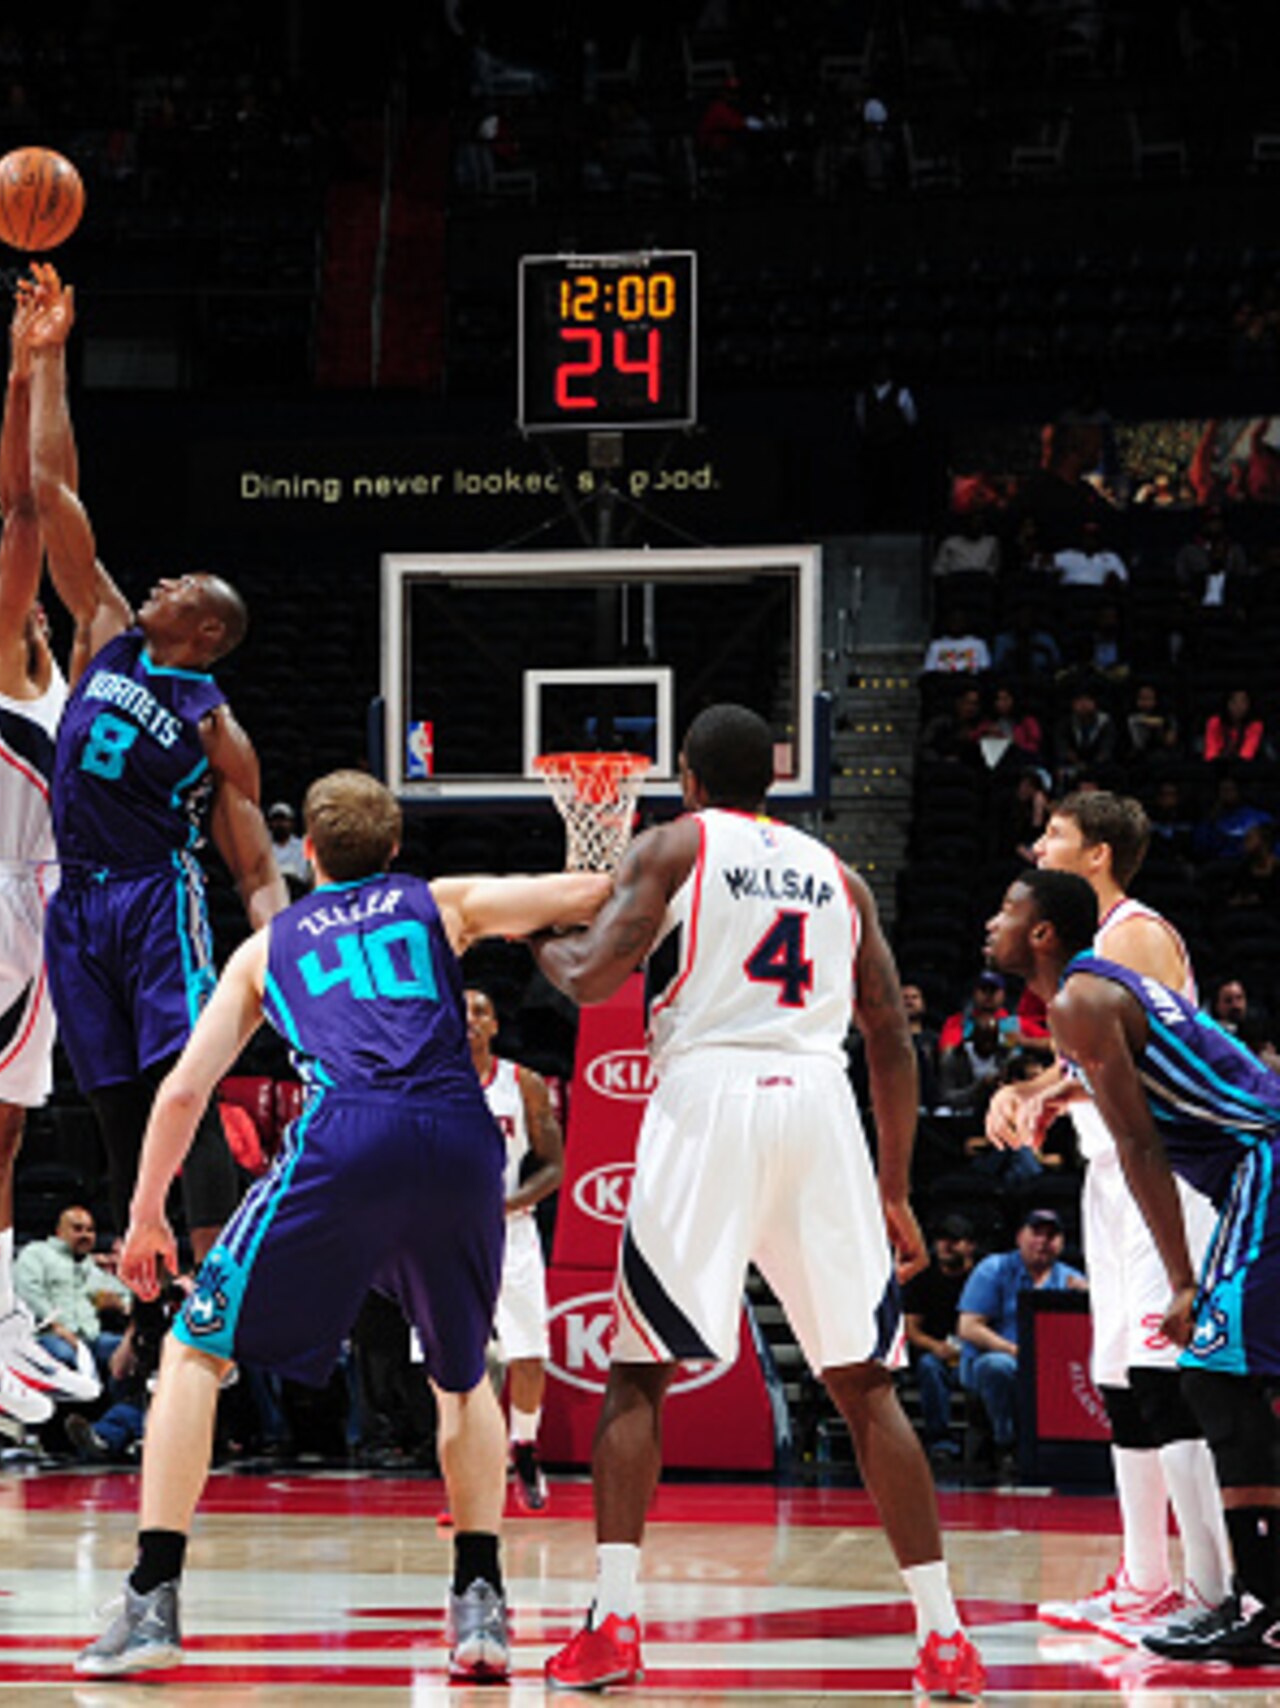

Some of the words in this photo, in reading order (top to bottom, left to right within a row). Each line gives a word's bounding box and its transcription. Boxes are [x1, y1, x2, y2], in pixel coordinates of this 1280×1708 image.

[560, 273, 676, 321] 12:00
[555, 327, 661, 409] 24
[240, 471, 342, 503] Dining
[353, 472, 443, 497] never
[81, 712, 139, 781] 8
[297, 919, 440, 1003] 40
[743, 908, 814, 1008] 4
